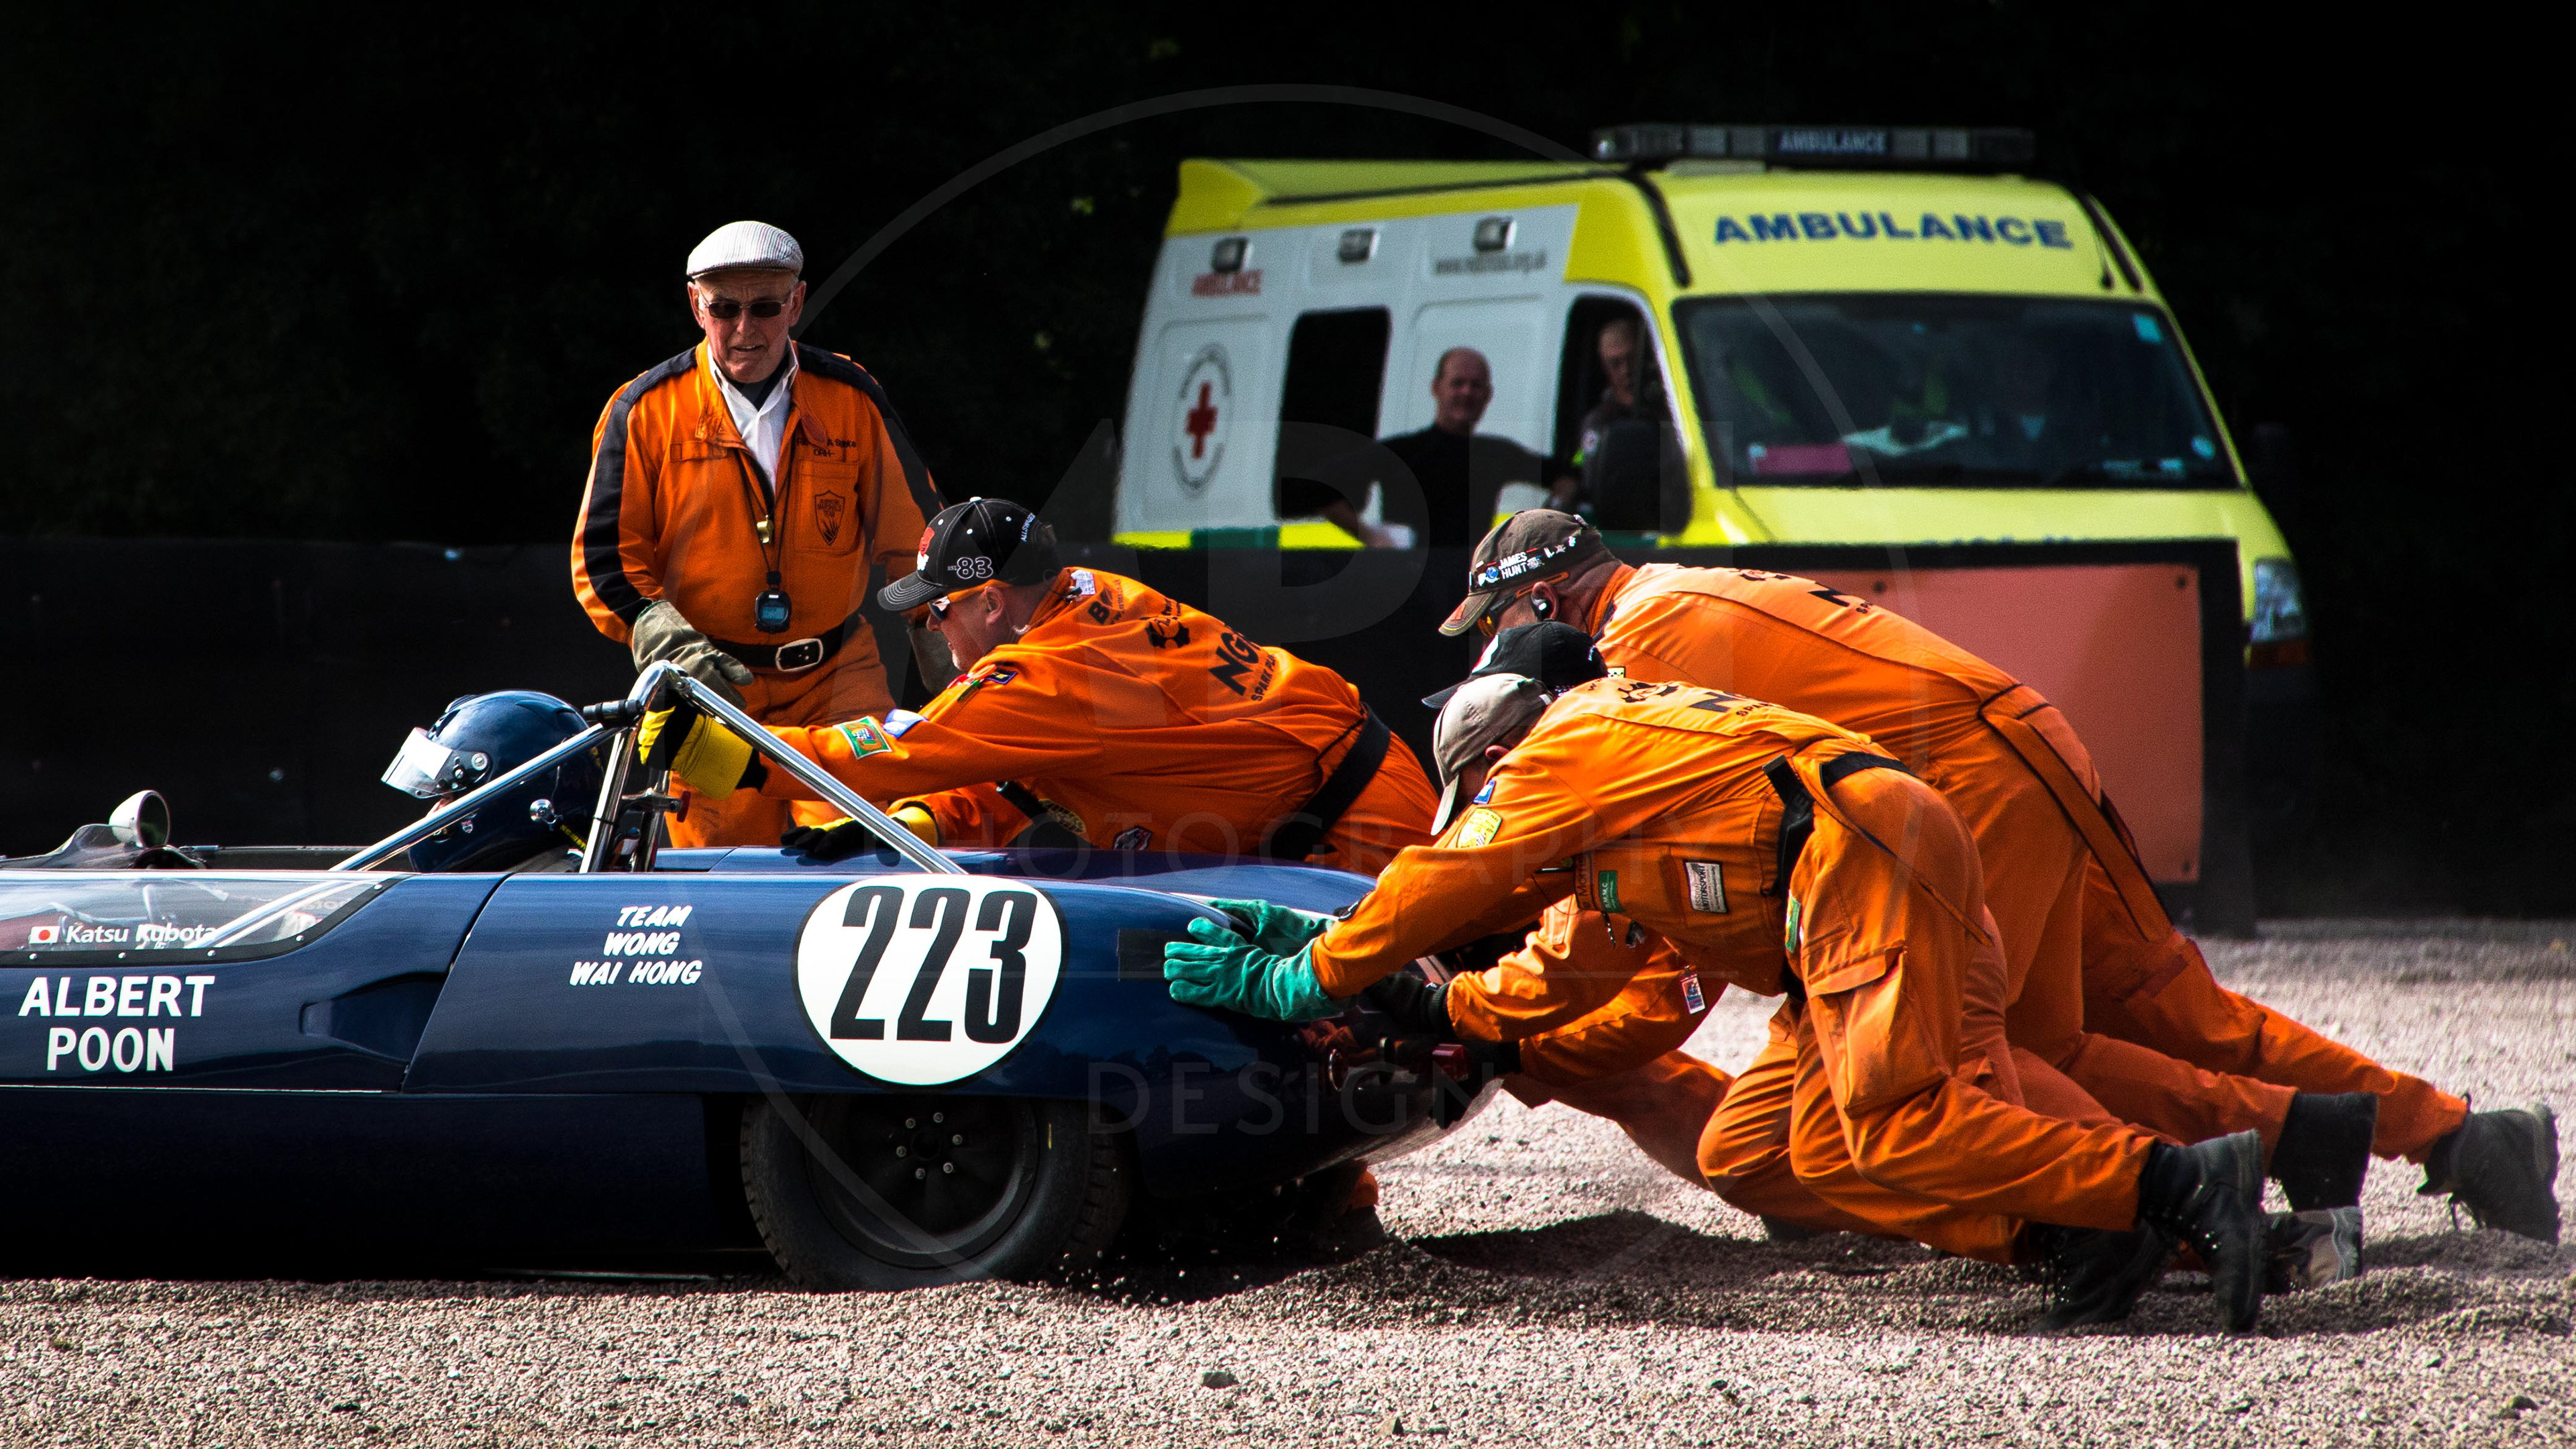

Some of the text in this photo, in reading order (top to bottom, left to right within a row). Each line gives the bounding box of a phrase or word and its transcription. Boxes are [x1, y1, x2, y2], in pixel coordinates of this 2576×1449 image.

[1778, 131, 1887, 154] AMBULANCE
[1713, 212, 2074, 250] AMBULANCE
[957, 556, 994, 580] 83
[1499, 551, 1528, 570] JAMES
[1501, 562, 1527, 580] HUNT
[616, 905, 693, 928] TEAM
[66, 922, 217, 943] Katsu Kubota
[603, 931, 680, 956] WONG
[570, 959, 703, 986] WAI HONG
[830, 885, 1038, 1044] 223
[18, 975, 215, 1017] ALBERT
[47, 1027, 174, 1072] POON
